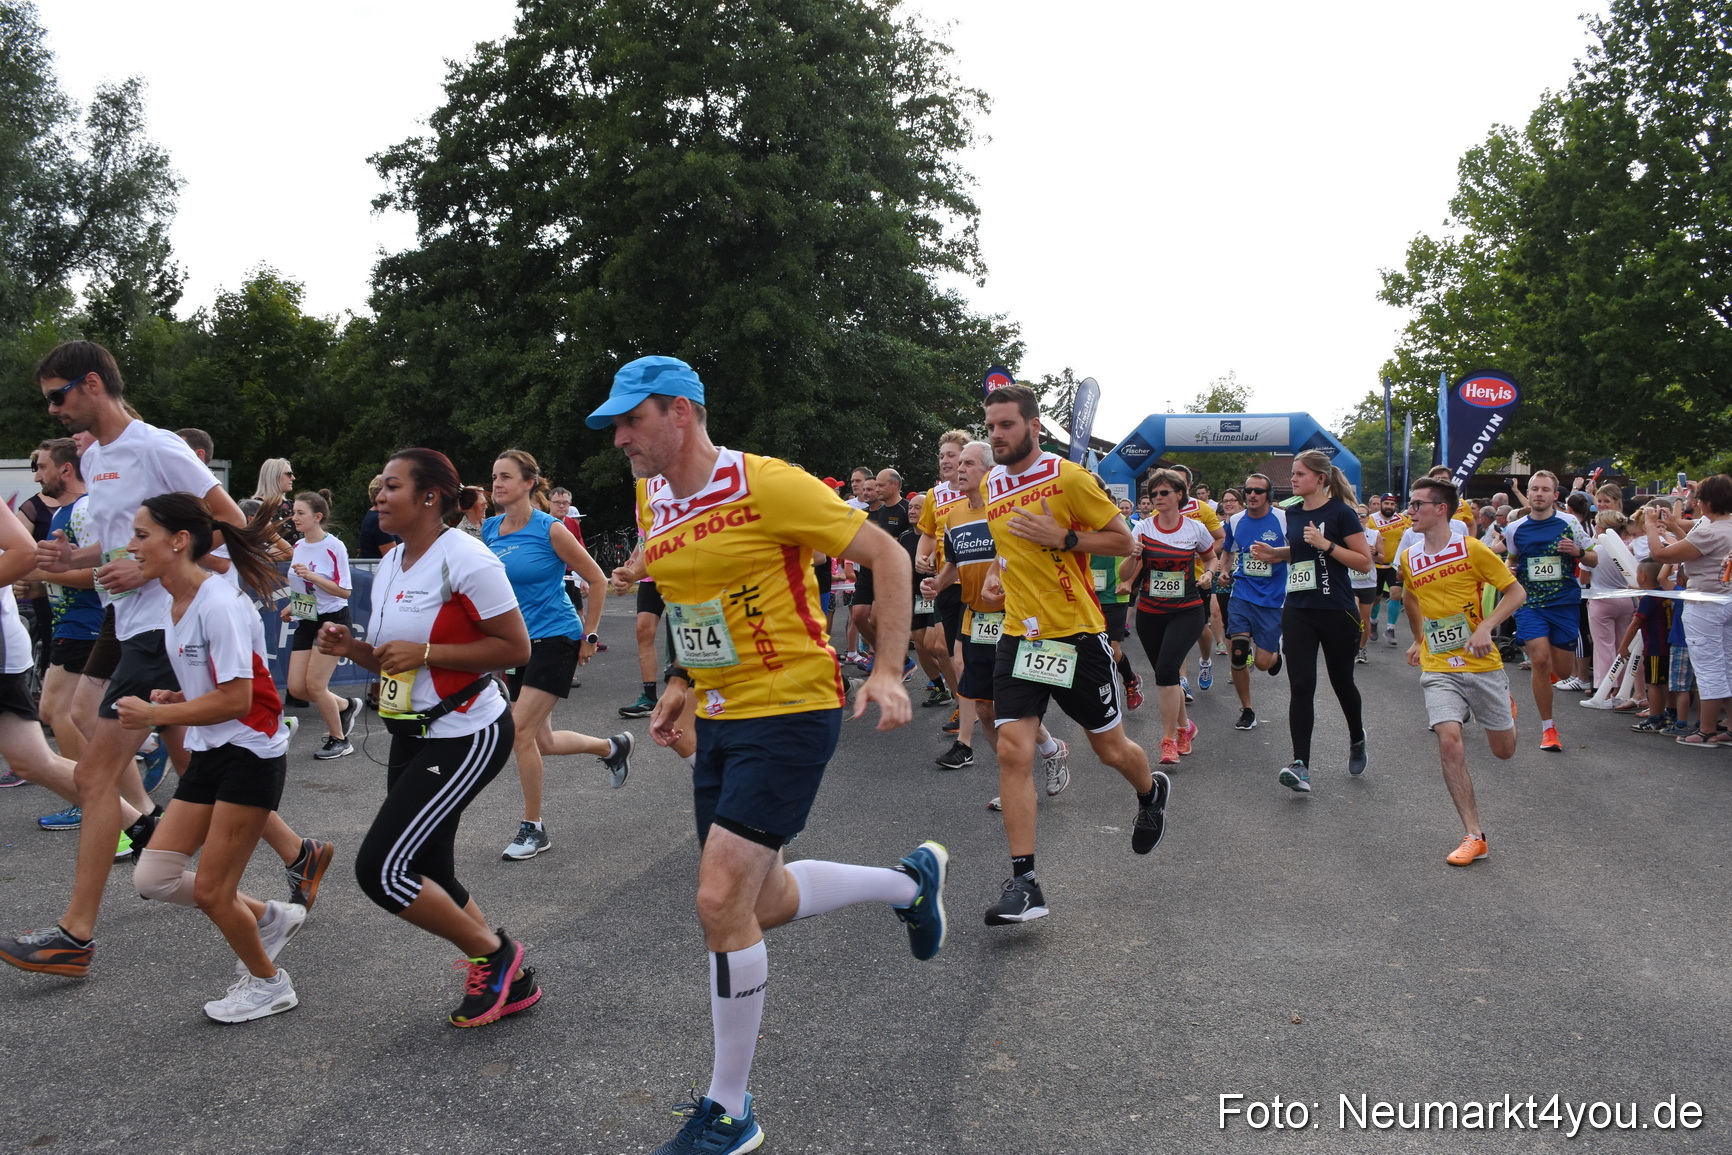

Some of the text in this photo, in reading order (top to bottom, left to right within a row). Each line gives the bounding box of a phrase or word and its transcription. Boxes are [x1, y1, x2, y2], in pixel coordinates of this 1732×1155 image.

[1466, 383, 1512, 402] Hervis
[1212, 432, 1258, 441] firmenlauf
[988, 484, 1063, 522] MAX BÖGL
[644, 506, 761, 566] MAX BÖGL
[957, 537, 995, 551] Fischer
[1246, 561, 1268, 570] 2323
[1317, 548, 1331, 595] RAIL.ON
[1534, 565, 1554, 575] 240
[1289, 571, 1310, 584] 1950
[1413, 562, 1472, 589] MAX BÖGL
[1153, 580, 1180, 591] 2268
[293, 600, 313, 613] 1777
[978, 623, 999, 636] 746
[1430, 625, 1463, 645] 1557
[676, 626, 722, 651] 1574
[1024, 652, 1068, 674] 1575
